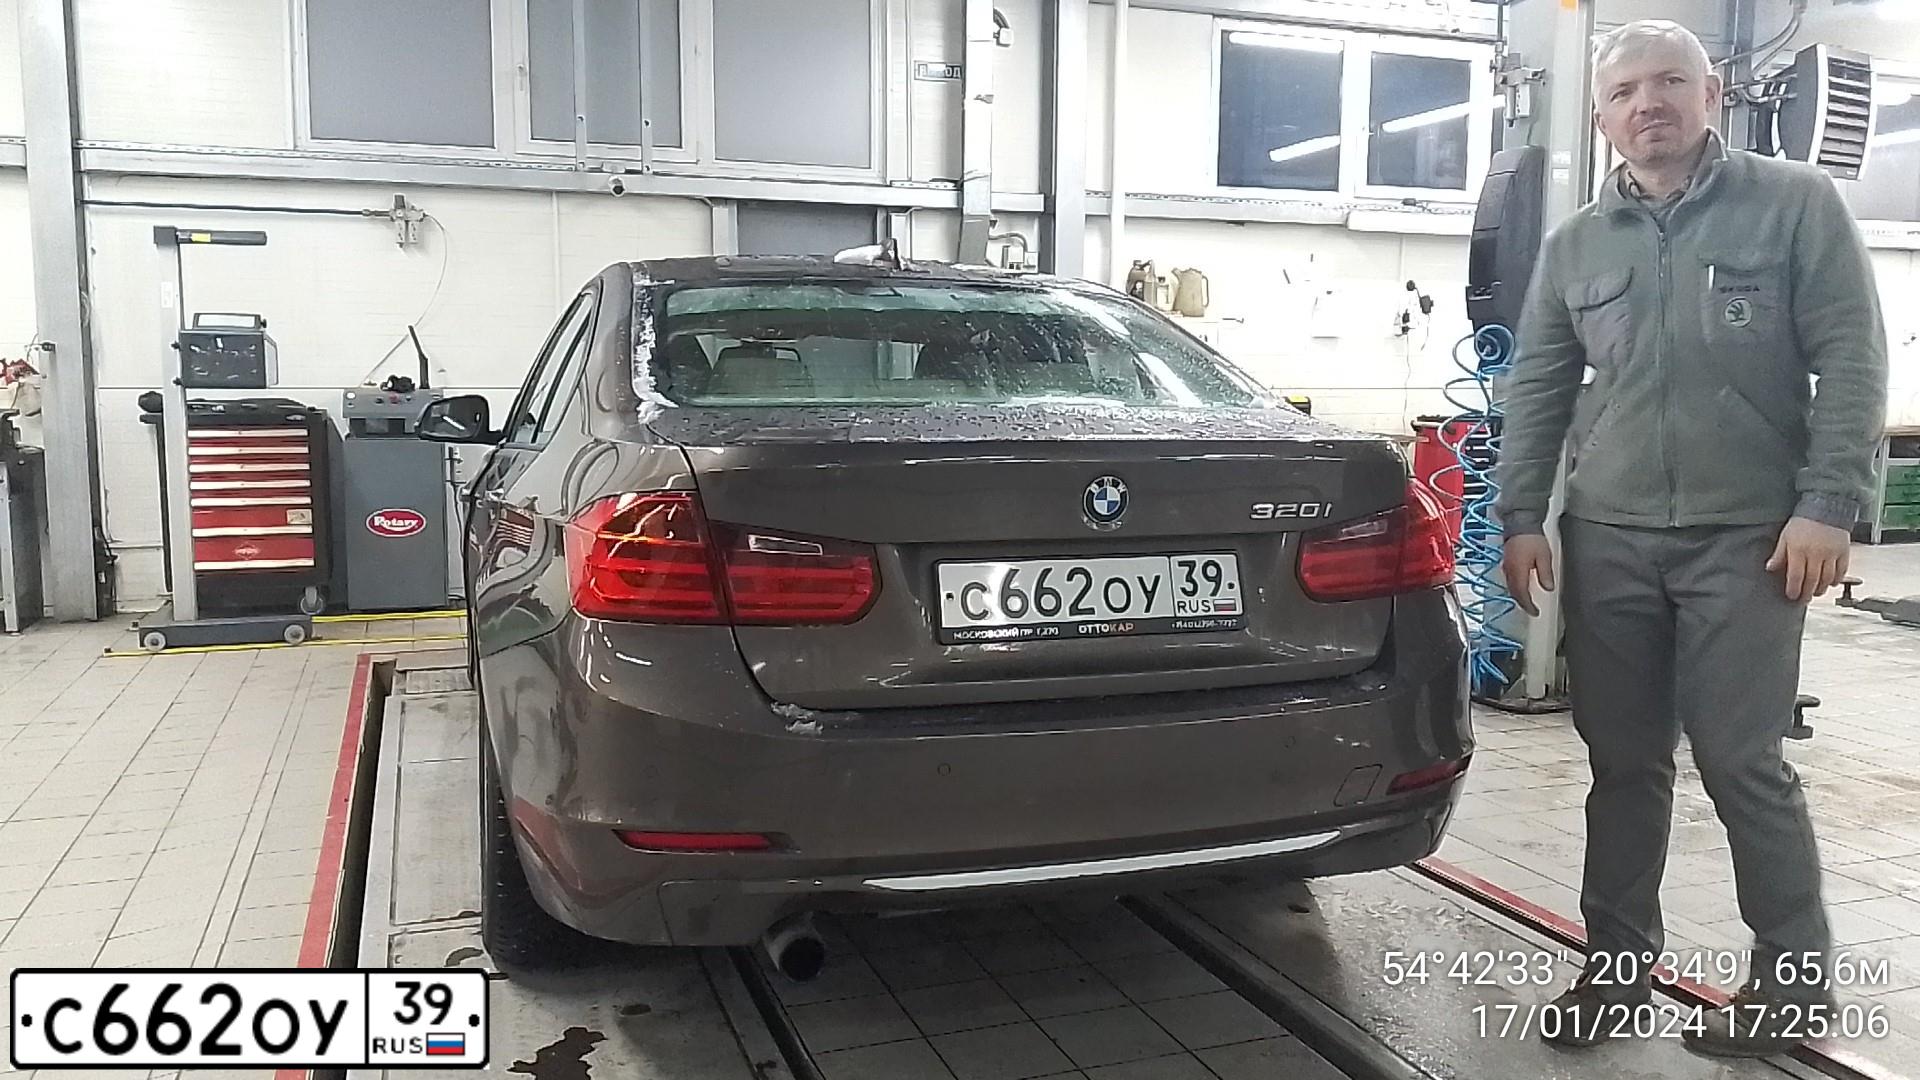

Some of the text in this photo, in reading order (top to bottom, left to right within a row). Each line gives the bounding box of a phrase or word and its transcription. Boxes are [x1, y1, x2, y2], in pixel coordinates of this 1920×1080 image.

[1090, 477, 1127, 493] BMW
[374, 516, 419, 531] Rotary
[1178, 559, 1223, 597] 39
[1177, 599, 1211, 613] RUS
